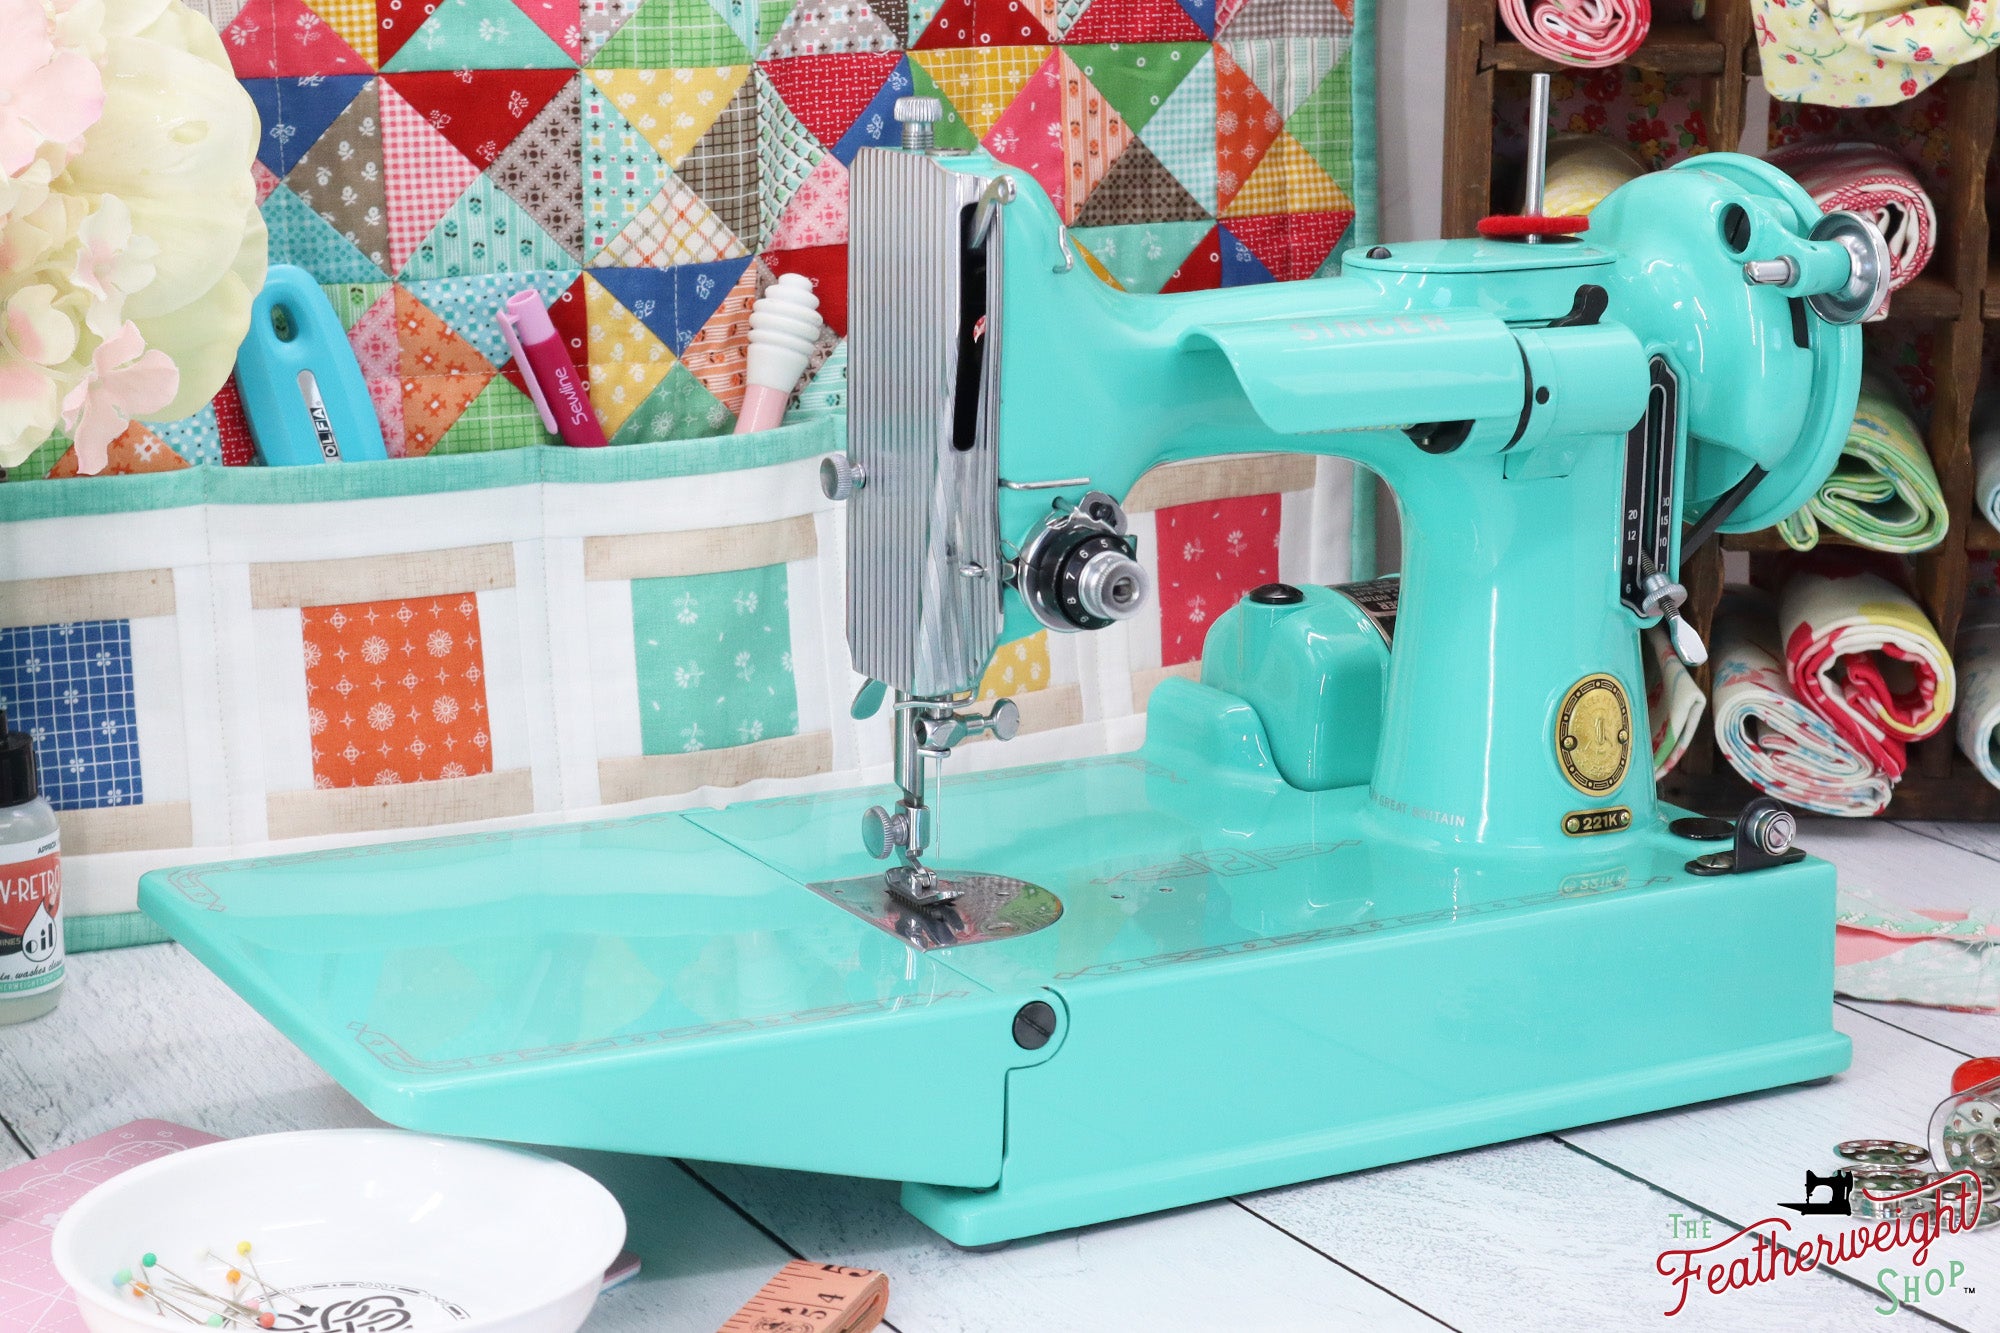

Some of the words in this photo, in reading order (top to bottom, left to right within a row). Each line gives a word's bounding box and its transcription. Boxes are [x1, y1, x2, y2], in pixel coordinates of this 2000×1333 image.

[1290, 315, 1451, 341] SINGER
[555, 366, 588, 426] Sewline
[312, 408, 338, 457] OLFA
[1628, 509, 1638, 520] 20
[1660, 515, 1669, 526] 15
[1627, 530, 1636, 541] 12
[1100, 538, 1108, 549] 5
[1659, 537, 1668, 547] 10
[1079, 549, 1089, 559] 6
[1627, 555, 1634, 566] 8
[1065, 571, 1076, 581] 7
[1625, 583, 1632, 594] 6
[1066, 596, 1077, 605] 8
[1411, 806, 1466, 827] BRITAIN
[1583, 813, 1618, 831] 221K
[25, 922, 54, 952] oil
